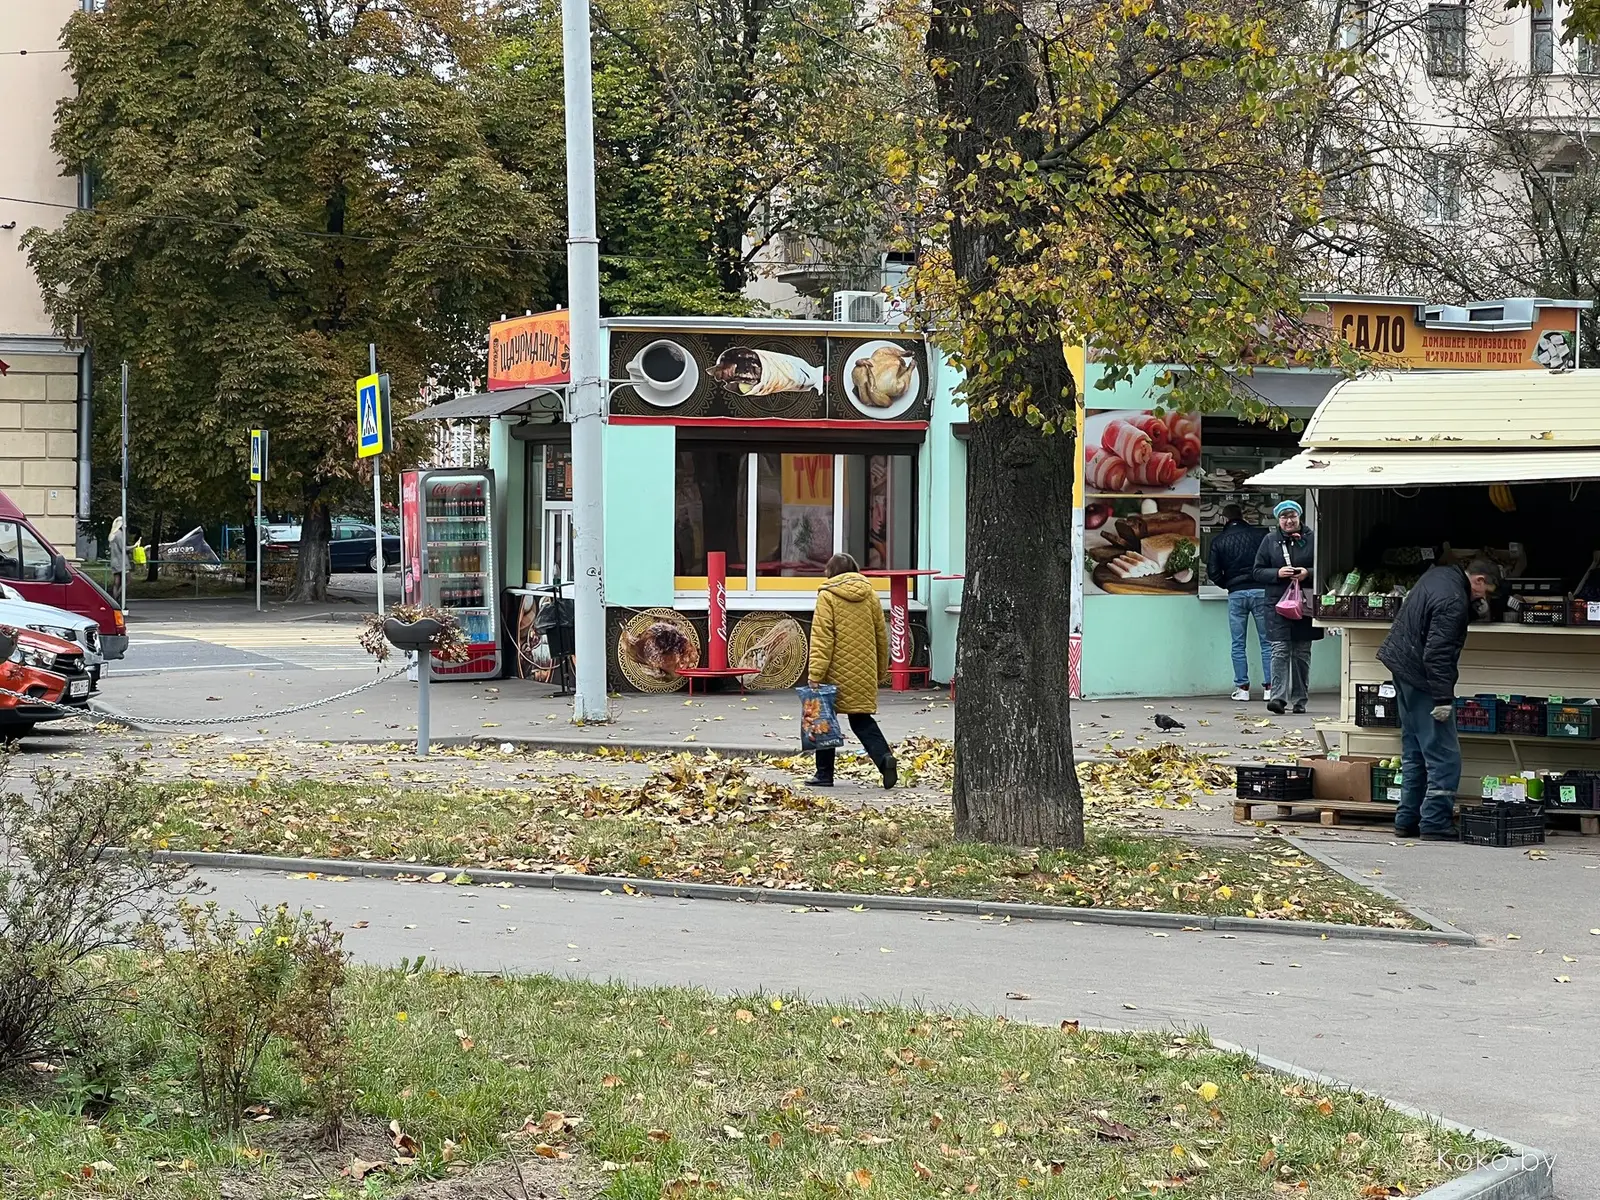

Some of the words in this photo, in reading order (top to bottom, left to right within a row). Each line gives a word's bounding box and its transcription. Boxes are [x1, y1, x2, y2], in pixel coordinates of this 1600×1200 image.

[1341, 314, 1405, 353] САЛО
[1422, 335, 1465, 348] ДОМАШНЕЕ
[1468, 337, 1527, 349] ПРОИЗВОДСТВО
[500, 330, 558, 372] ШАУРМАНКА
[1425, 350, 1482, 363] НАТУРАЛЬНЫЙ
[1486, 352, 1522, 363] ПРОДУКТ
